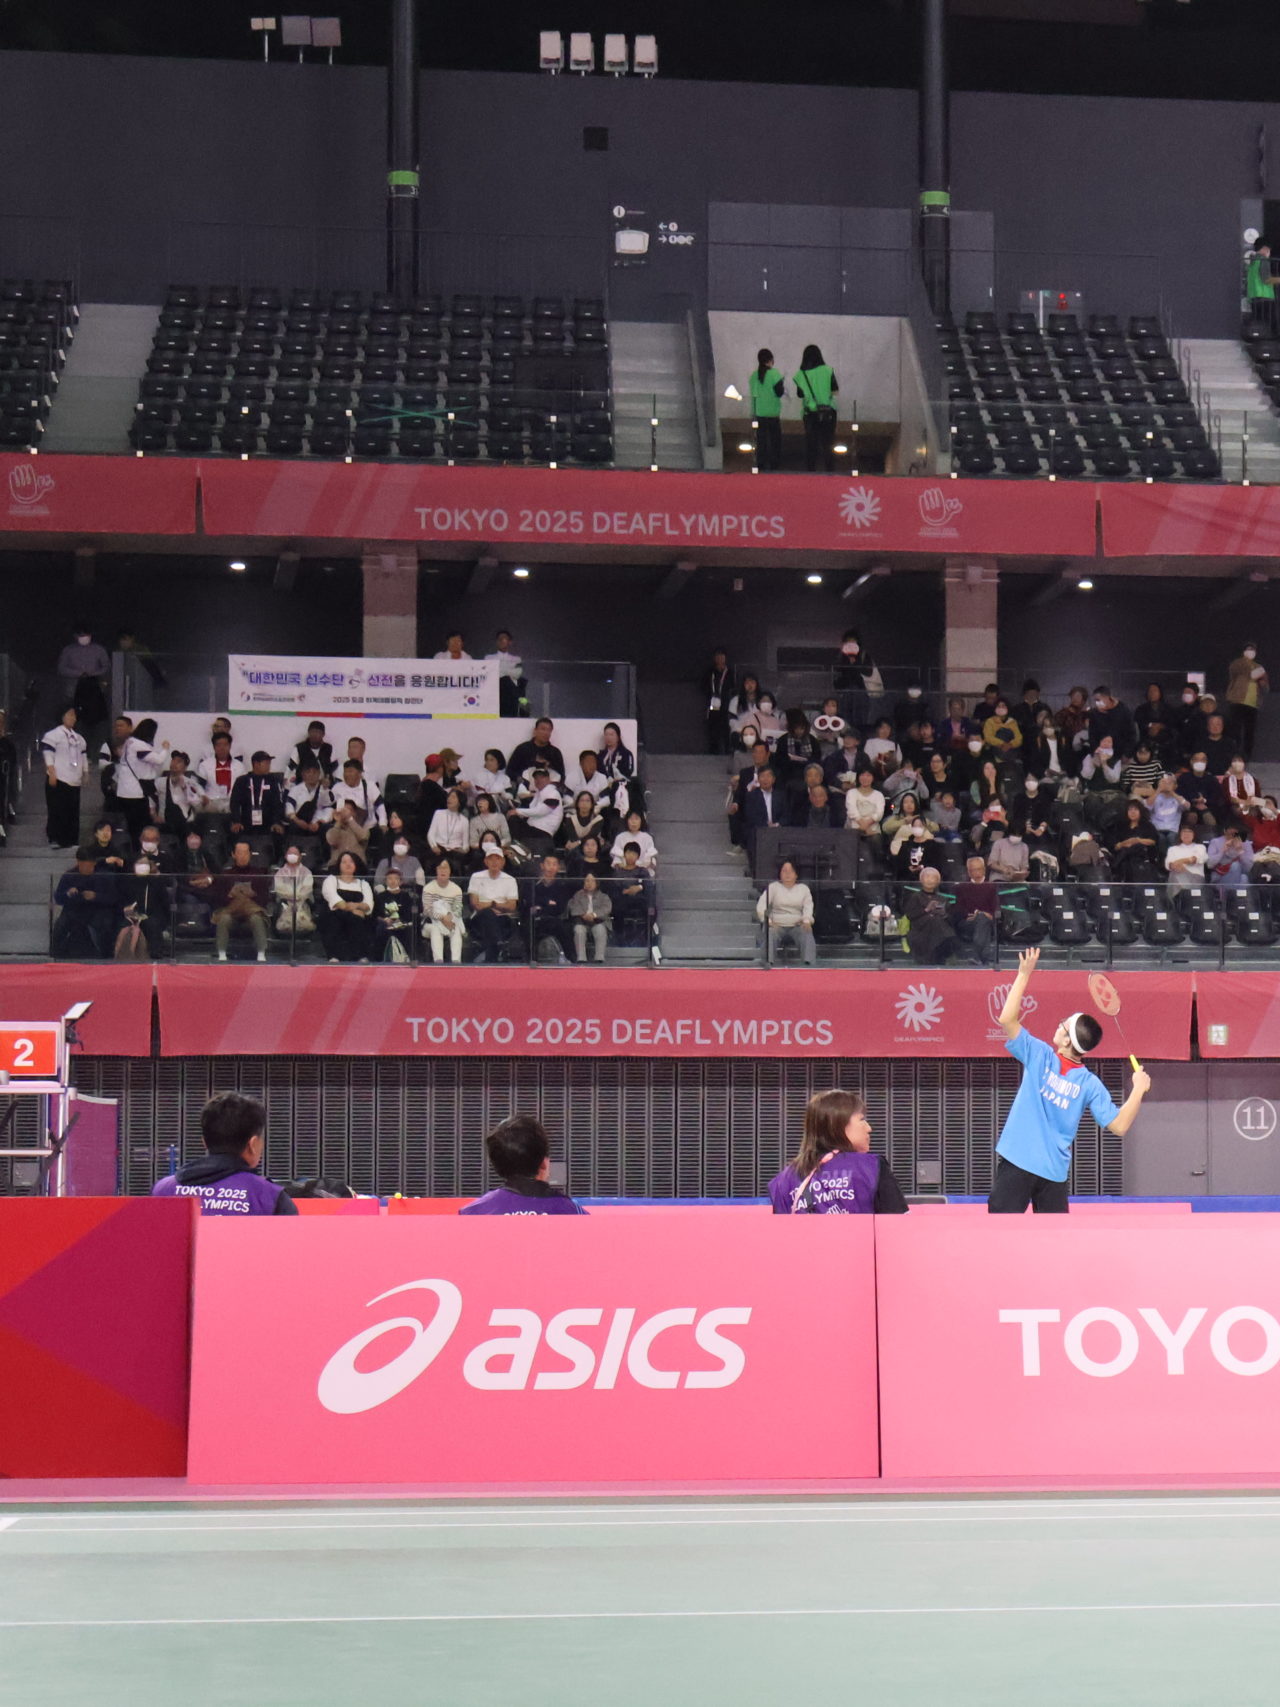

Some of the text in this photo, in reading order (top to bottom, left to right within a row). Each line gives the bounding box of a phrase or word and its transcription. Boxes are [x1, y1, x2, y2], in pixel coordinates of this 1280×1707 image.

[414, 507, 786, 539] TOKYO 2025 DEAFLYMPICS
[406, 1017, 833, 1046] TOKYO 2025 DEAFLYMPICS
[13, 1038, 35, 1067] 2
[1040, 1085, 1070, 1110] JAPAN
[1242, 1105, 1269, 1130] 11
[175, 1185, 248, 1199] TOKYO 2025
[463, 1307, 752, 1390] asics
